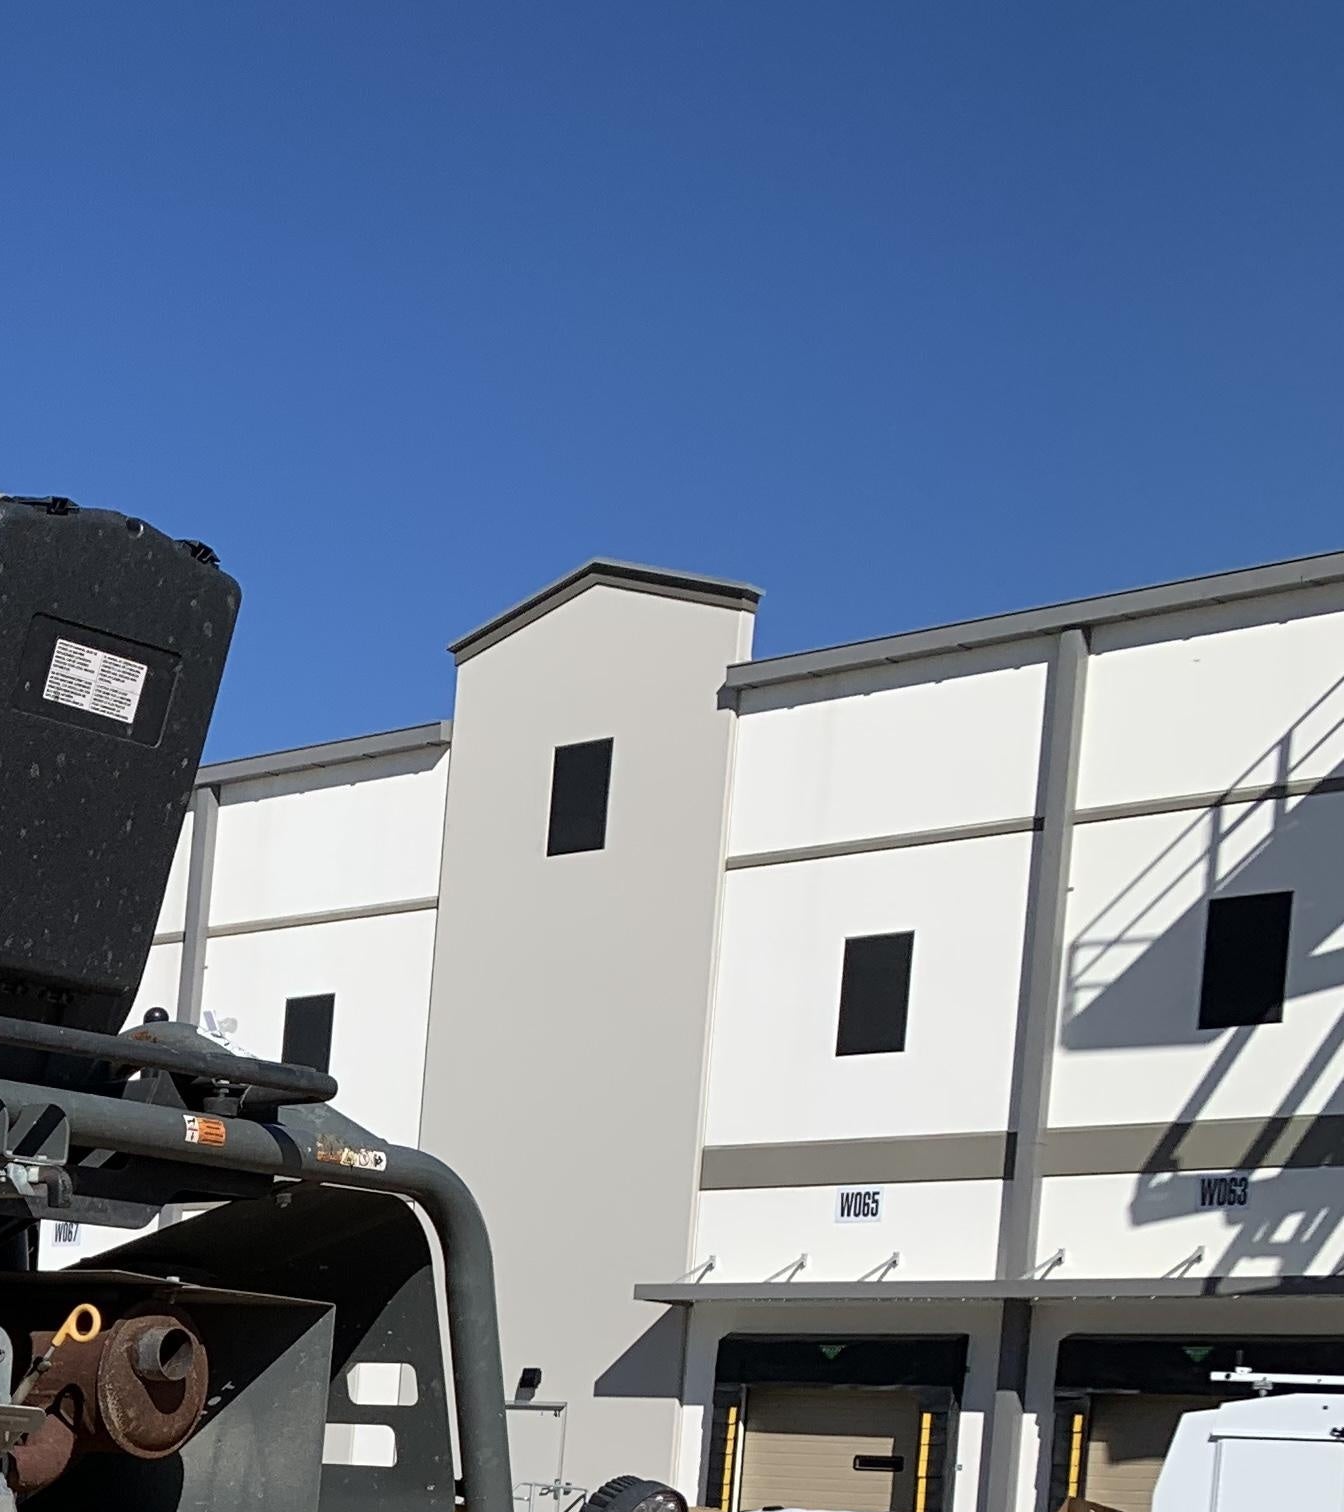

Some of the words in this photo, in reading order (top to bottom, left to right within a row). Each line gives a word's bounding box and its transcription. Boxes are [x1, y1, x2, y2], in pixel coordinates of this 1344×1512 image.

[840, 1191, 880, 1217] W065
[1200, 1177, 1248, 1206] W063
[54, 1222, 79, 1242] W067
